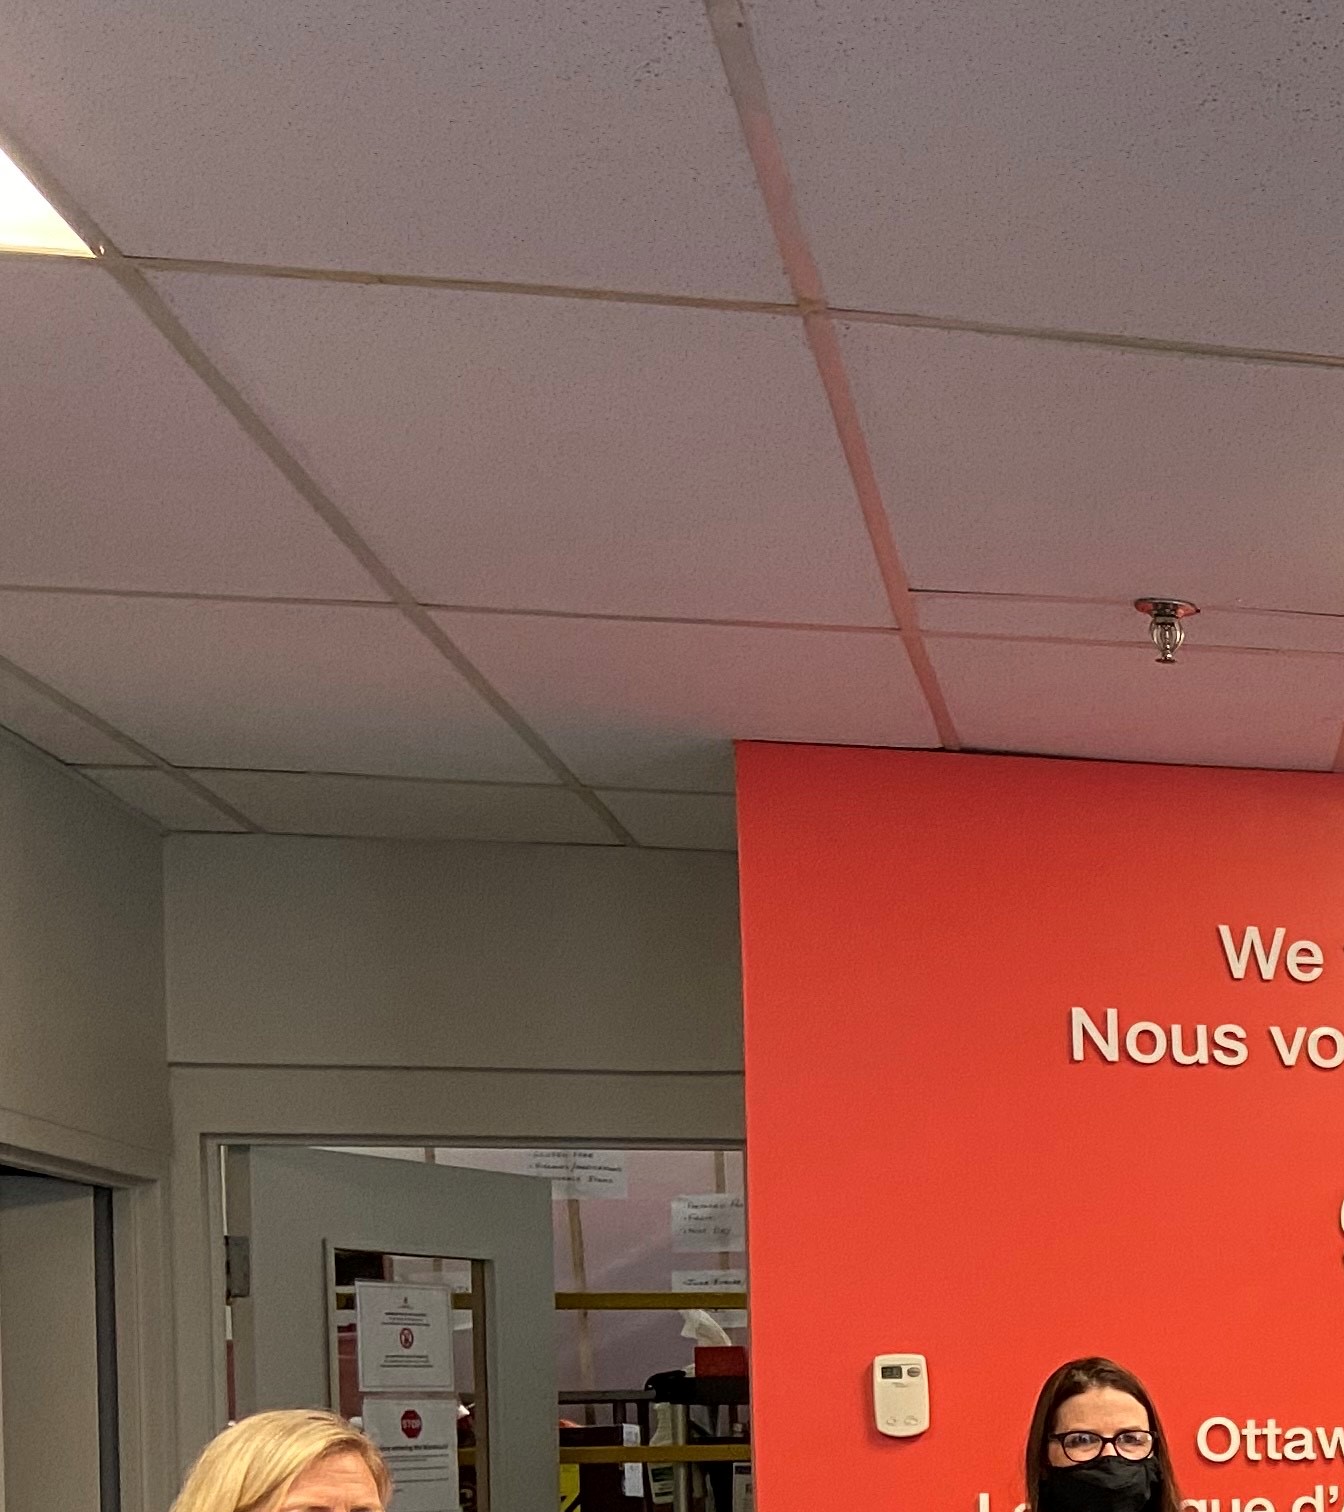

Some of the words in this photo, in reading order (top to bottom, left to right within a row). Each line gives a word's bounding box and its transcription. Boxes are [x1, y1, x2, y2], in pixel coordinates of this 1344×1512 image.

[1218, 924, 1324, 982] We
[1071, 1006, 1249, 1066] Nous
[402, 1418, 421, 1430] STOP
